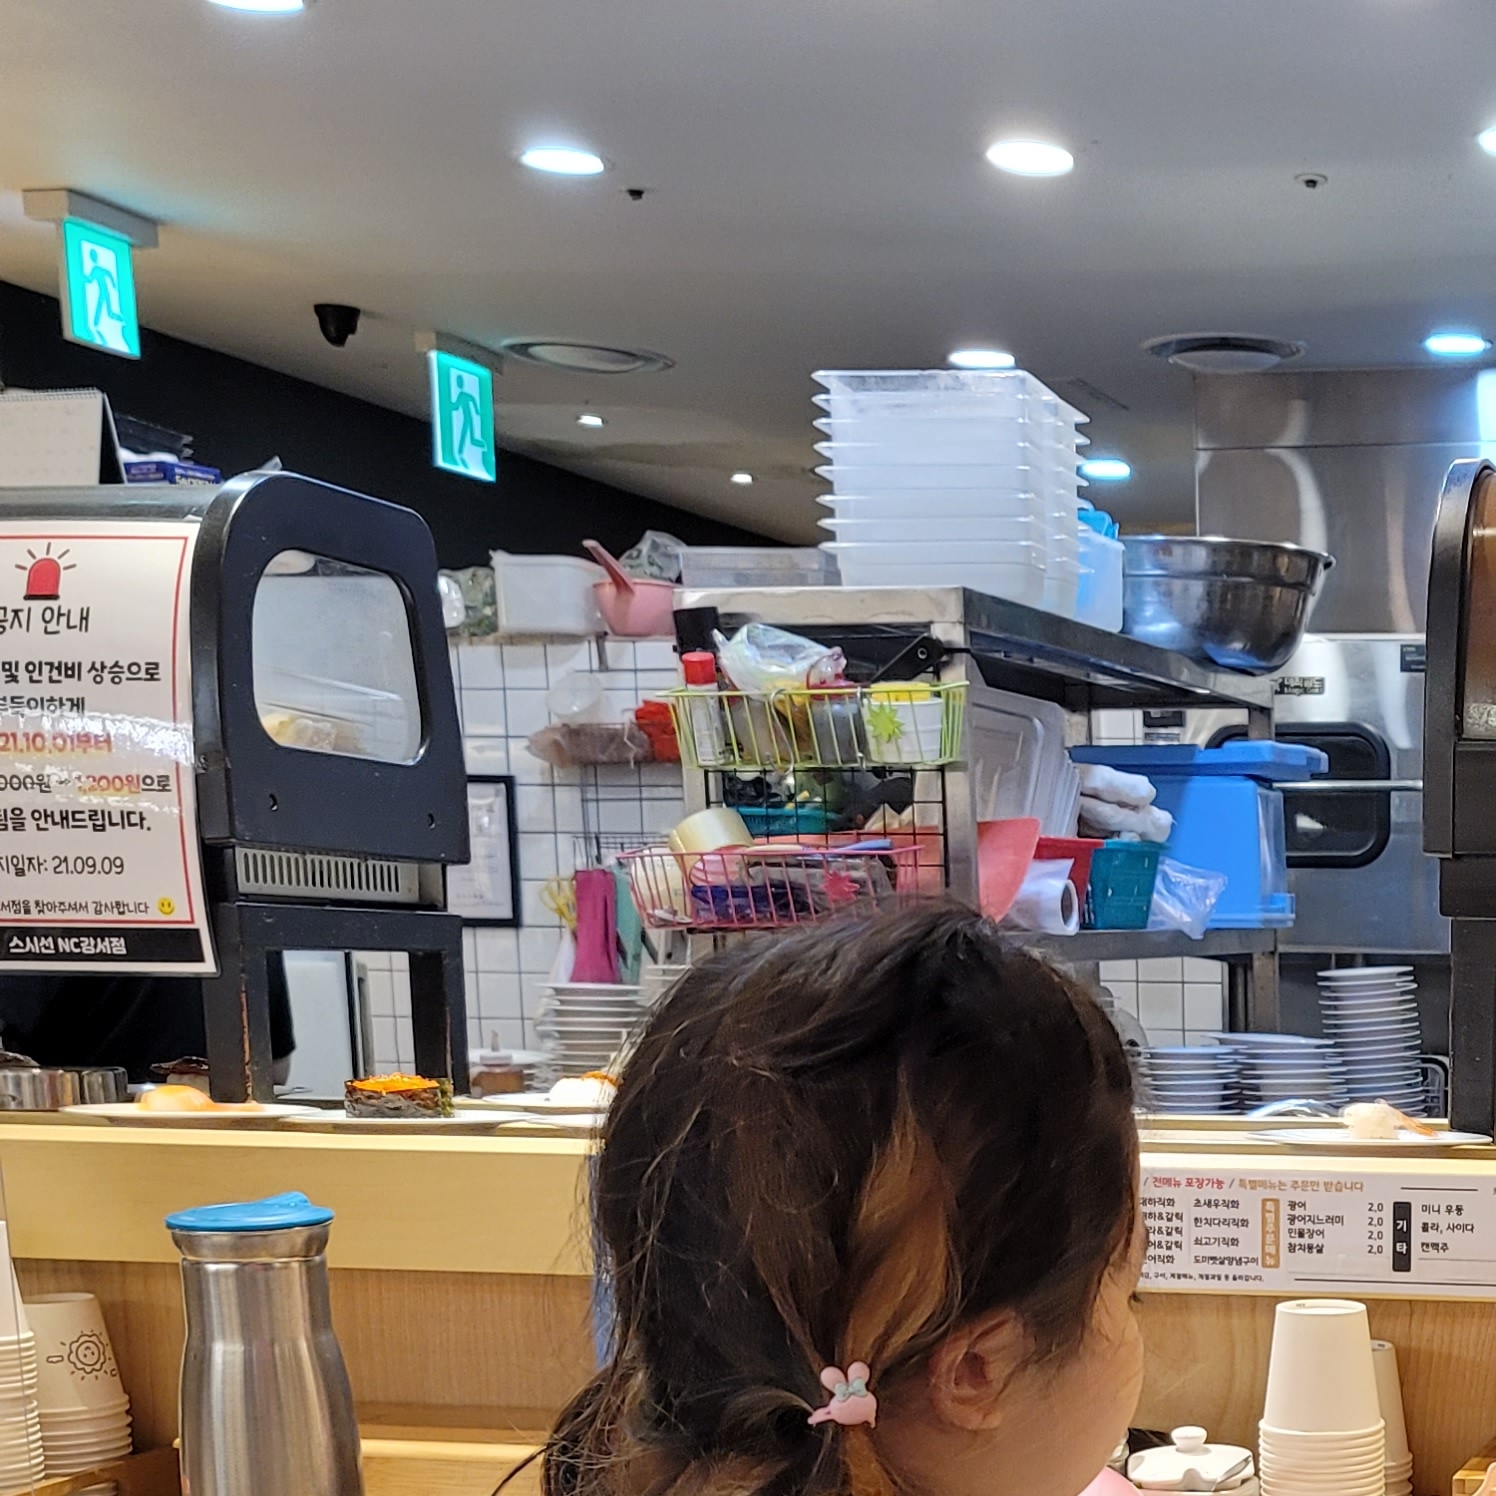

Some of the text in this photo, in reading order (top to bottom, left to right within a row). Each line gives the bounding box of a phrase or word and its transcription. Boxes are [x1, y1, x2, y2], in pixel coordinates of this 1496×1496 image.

[41, 604, 91, 635] 안내
[1, 660, 161, 685] 및 인건비 상승으로
[31, 808, 151, 832] 안내드립니다.
[52, 856, 124, 875] 21.09.09
[35, 900, 89, 915] 찾아주셔서
[92, 901, 149, 915] 감사합니다
[9, 936, 127, 954] 스시선 NC강서점
[1153, 1177, 1182, 1188] 전메뉴
[1185, 1177, 1225, 1189] 포장가능
[1290, 1180, 1320, 1192] 주문만
[1323, 1181, 1364, 1192] 받습니다
[1287, 1200, 1306, 1211] 광어
[1421, 1204, 1440, 1215] 미니
[1444, 1204, 1464, 1216] 우동
[1193, 1217, 1249, 1228] 한치다리직화
[1287, 1213, 1344, 1226] 광어지느러미
[1287, 1228, 1325, 1239] 민물장어
[1446, 1222, 1475, 1233] 사이다
[1193, 1237, 1240, 1248] 쇠고기직화
[1421, 1242, 1449, 1253] 캔맥주
